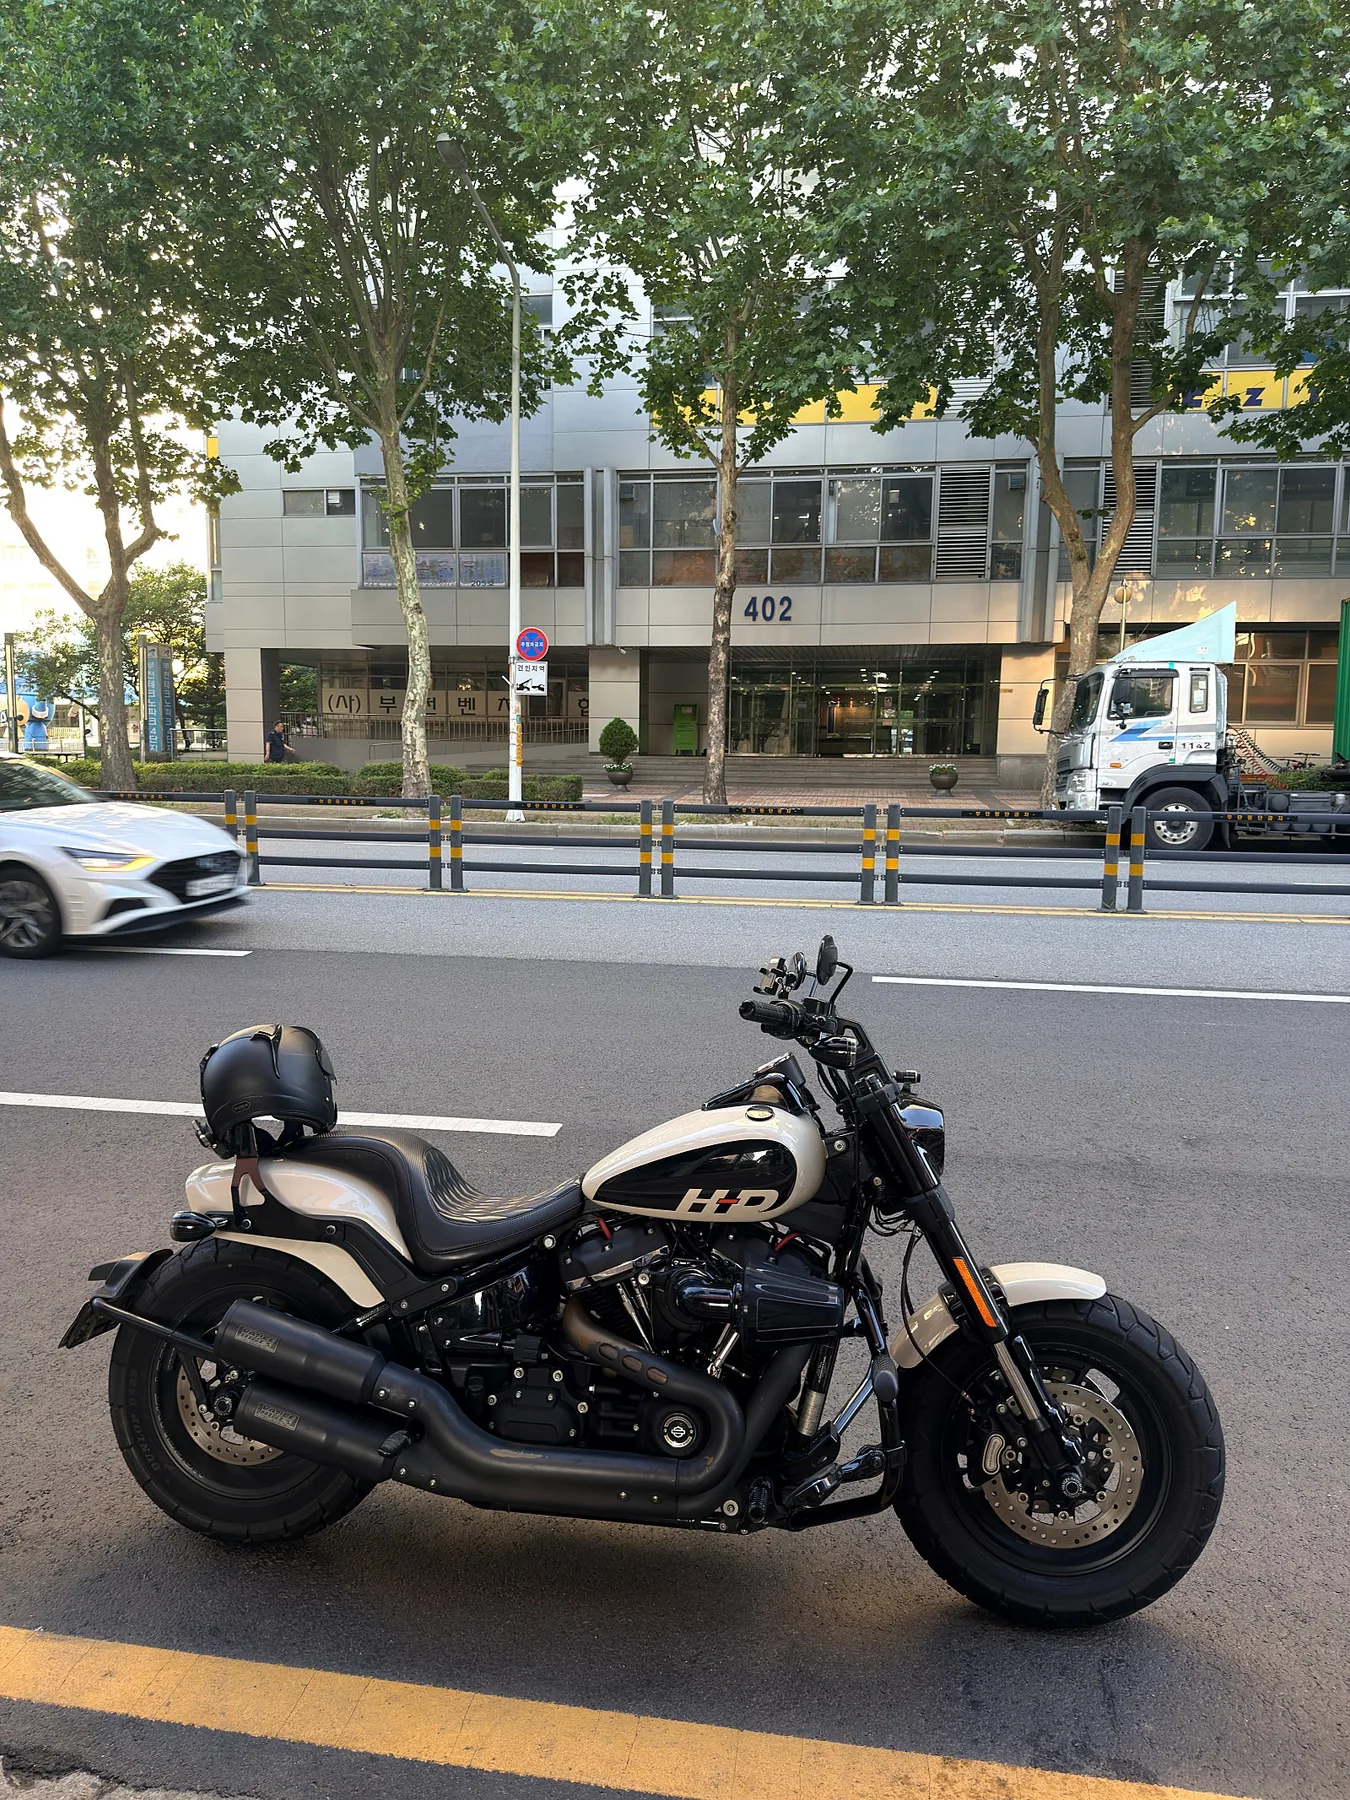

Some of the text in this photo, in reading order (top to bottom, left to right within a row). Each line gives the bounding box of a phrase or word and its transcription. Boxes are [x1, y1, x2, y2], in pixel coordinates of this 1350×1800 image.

[744, 596, 792, 621] 402
[517, 664, 545, 672] 견인지역
[1181, 741, 1211, 749] 1142
[675, 1188, 779, 1214] H-D
